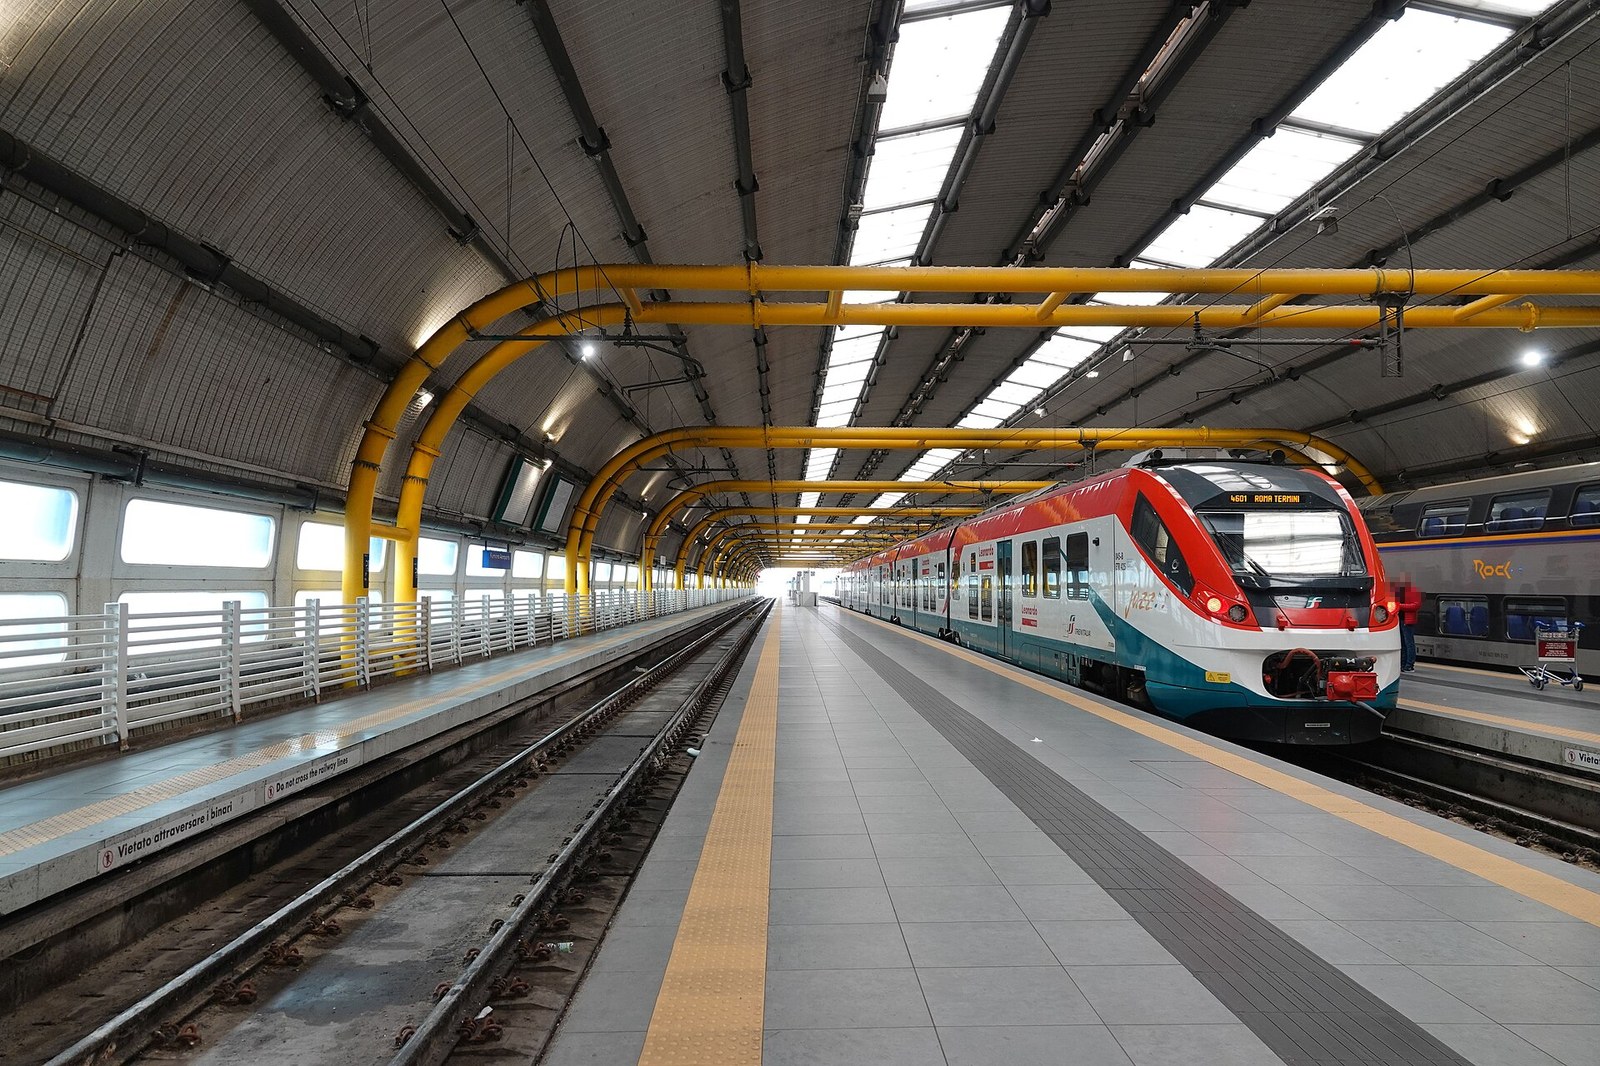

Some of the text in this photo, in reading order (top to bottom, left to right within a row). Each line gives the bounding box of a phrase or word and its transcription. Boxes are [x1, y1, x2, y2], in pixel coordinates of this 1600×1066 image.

[1230, 494, 1300, 503] 4601 ROMA TERMINI
[1473, 559, 1512, 580] Rock
[1579, 752, 1600, 765] Vieta
[275, 757, 349, 793] Do not cross the railway lines
[117, 837, 152, 858] Vietato
[154, 815, 205, 843] attraversare
[210, 801, 233, 820] binari
